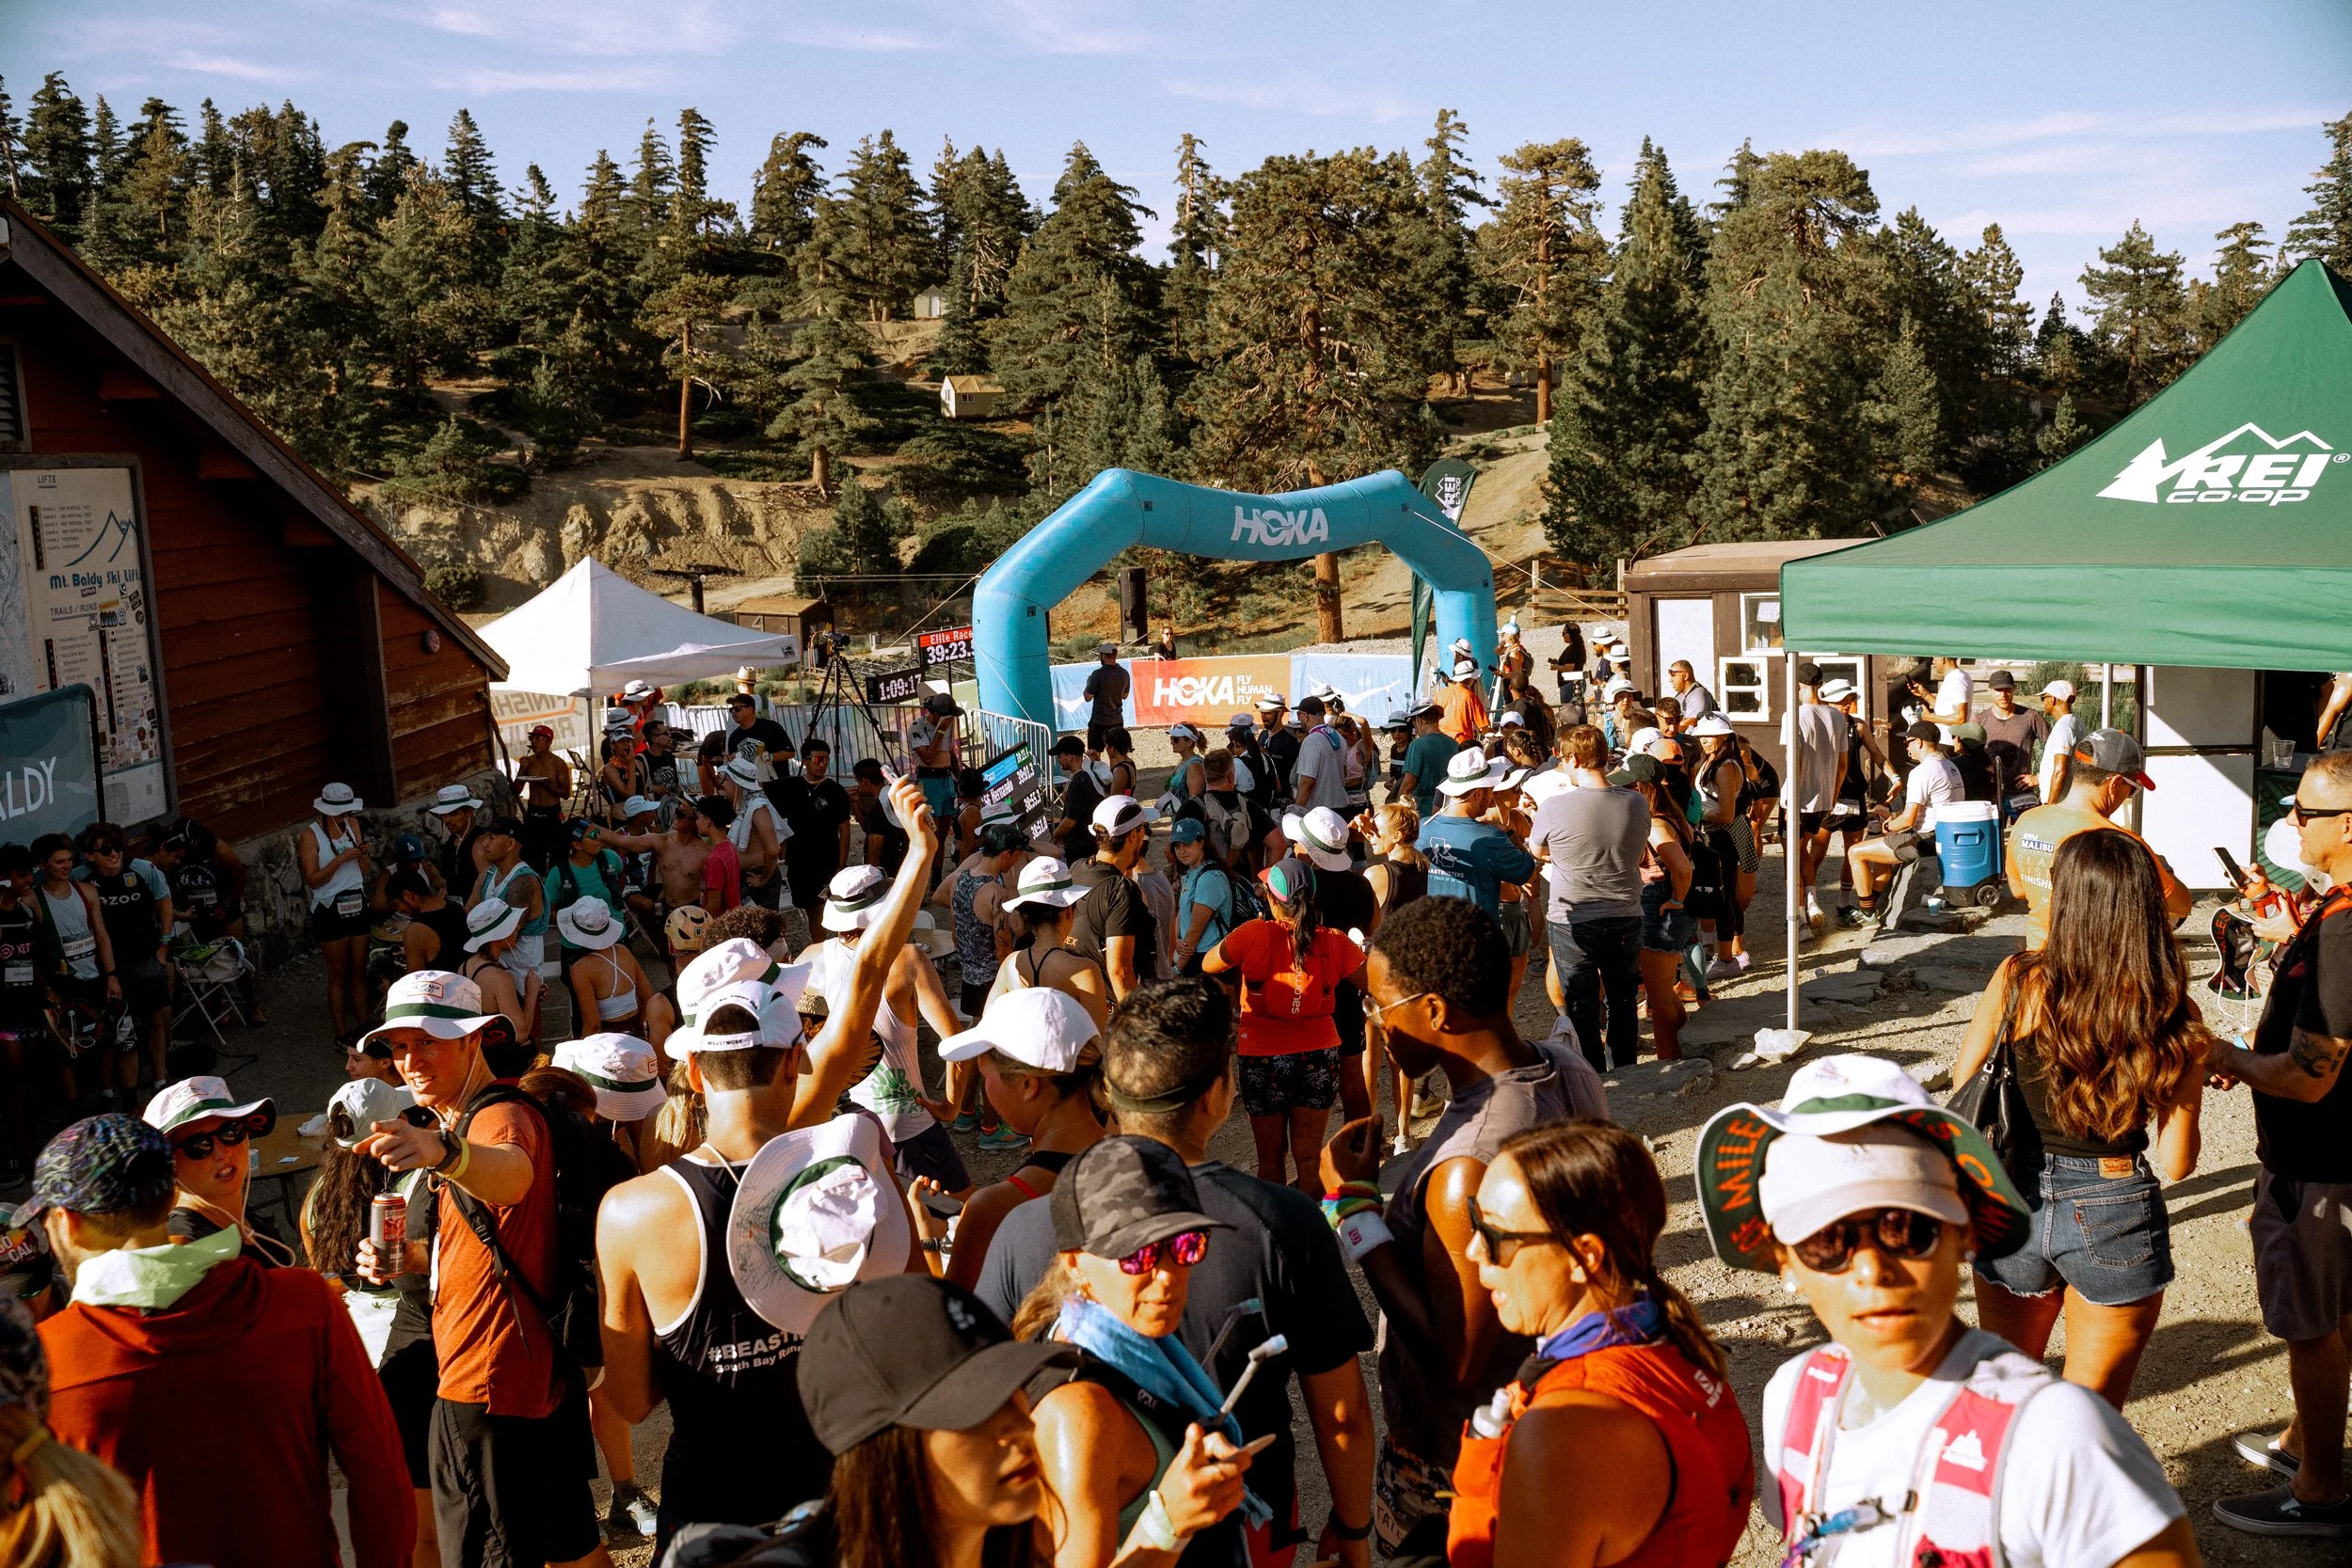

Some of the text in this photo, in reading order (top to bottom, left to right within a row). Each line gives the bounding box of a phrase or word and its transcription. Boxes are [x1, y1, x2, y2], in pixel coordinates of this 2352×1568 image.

[38, 475, 56, 483] LIFTS
[2174, 453, 2331, 488] REI
[1444, 477, 1455, 505] REI
[1231, 505, 1329, 546] HOKA
[50, 575, 69, 590] Mt.
[72, 573, 103, 588] Baldy
[106, 571, 120, 584] Ski
[50, 606, 73, 616] TRAILS
[80, 602, 97, 612] RUNS
[930, 629, 973, 644] Elite Race
[879, 673, 922, 701] 1:09:17
[1236, 674, 1251, 685] FLY
[1153, 674, 1234, 707] HOKA
[1236, 685, 1273, 695] HUMAN
[1236, 695, 1251, 705] FLY
[0, 756, 56, 821] LDY
[2021, 840, 2053, 852] MALIBU
[1717, 1111, 1770, 1212] MILE
[8, 1242, 33, 1264] CAL
[707, 1331, 806, 1363] #BEASTM
[753, 1355, 776, 1368] Bay
